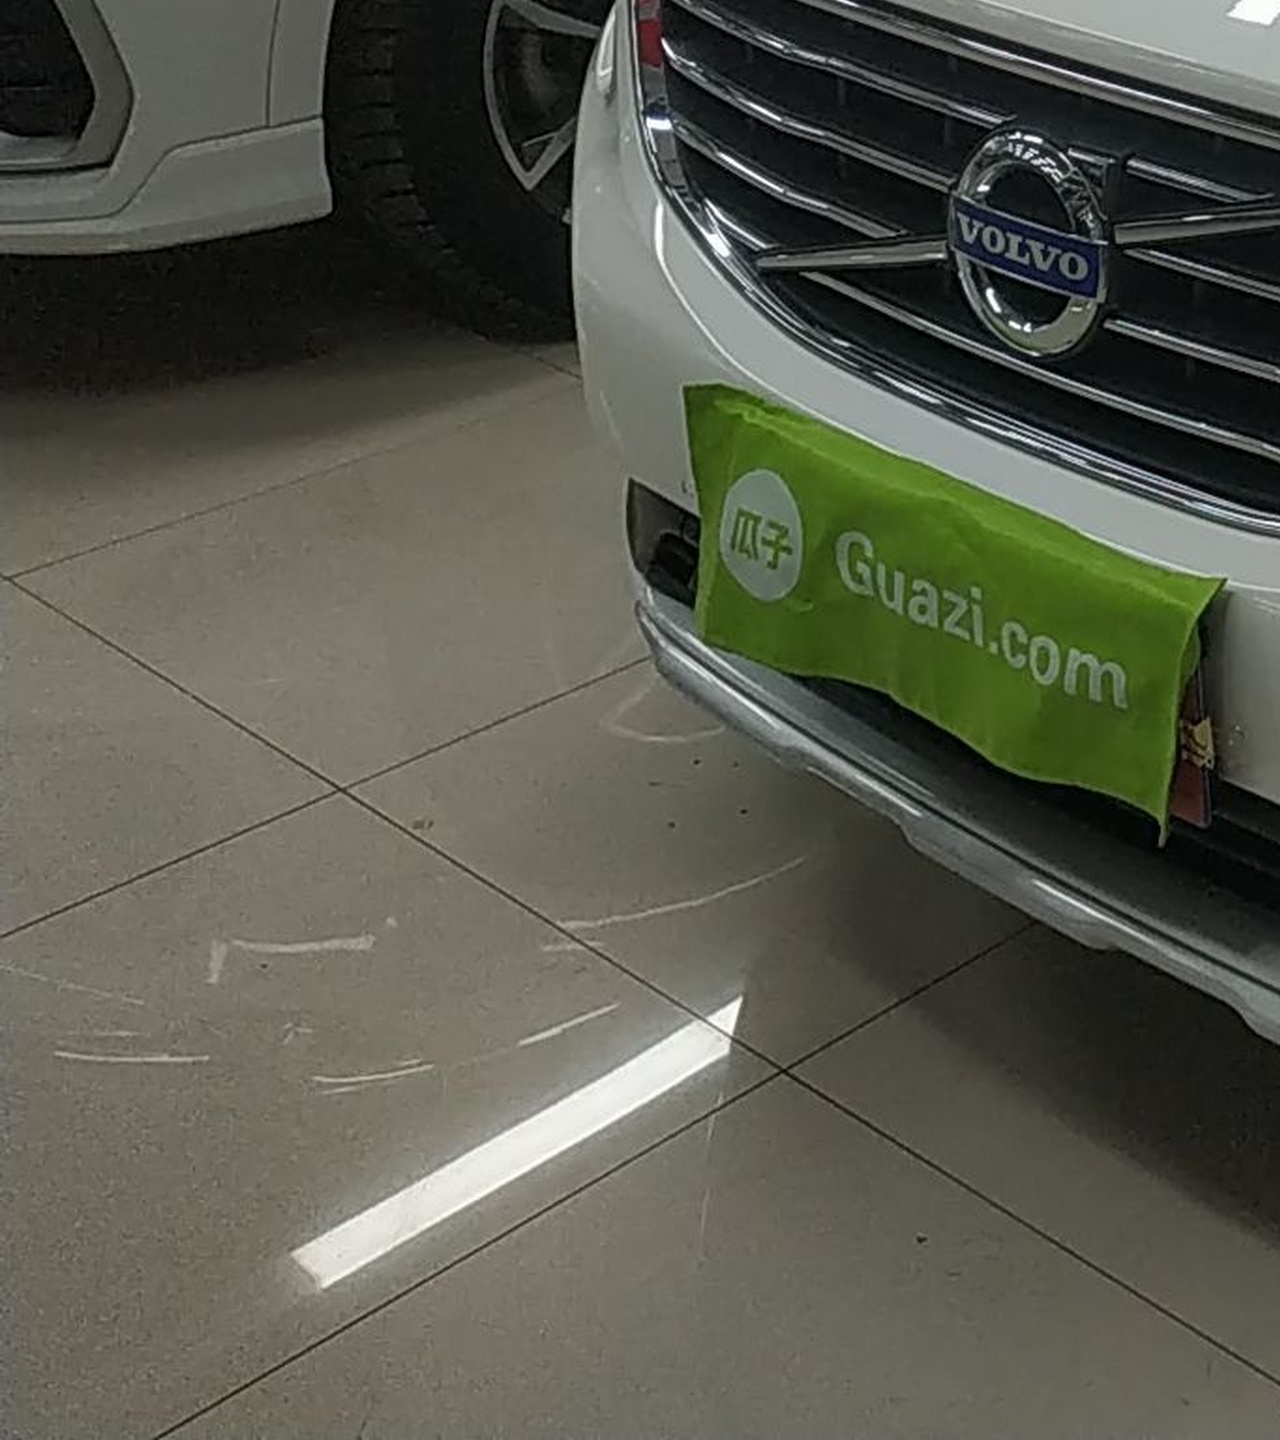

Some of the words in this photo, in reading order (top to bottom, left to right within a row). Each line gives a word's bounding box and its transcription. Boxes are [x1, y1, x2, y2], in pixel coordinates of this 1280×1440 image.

[957, 212, 1089, 281] VOLVO
[730, 508, 793, 570] 瓜子
[835, 531, 1128, 709] Guazi.com
